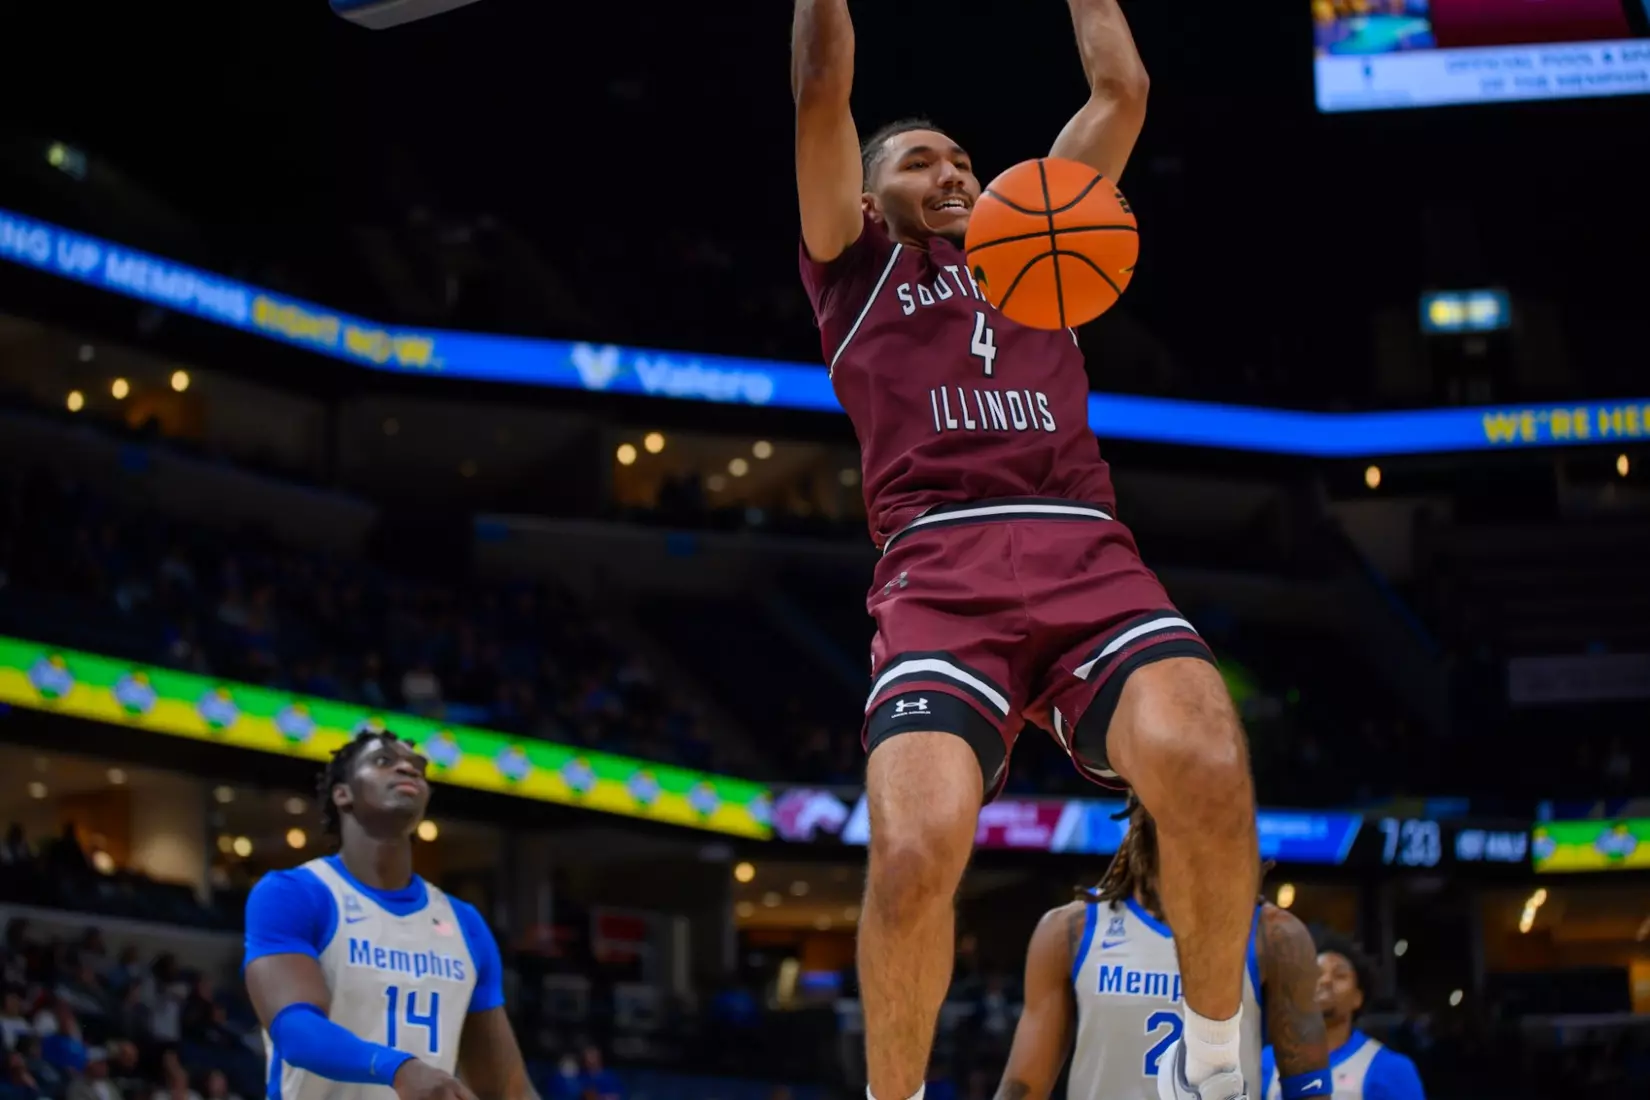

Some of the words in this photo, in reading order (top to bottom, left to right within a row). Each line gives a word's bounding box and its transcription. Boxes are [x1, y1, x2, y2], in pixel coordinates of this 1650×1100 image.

[57, 237, 99, 272] UP
[896, 265, 998, 316] SOUTH
[970, 311, 997, 376] 4
[930, 385, 1057, 433] ILLINOIS
[349, 937, 466, 982] Memphis
[1099, 964, 1185, 1002] Memp
[385, 984, 440, 1054] 14
[1143, 1011, 1184, 1076] 2
